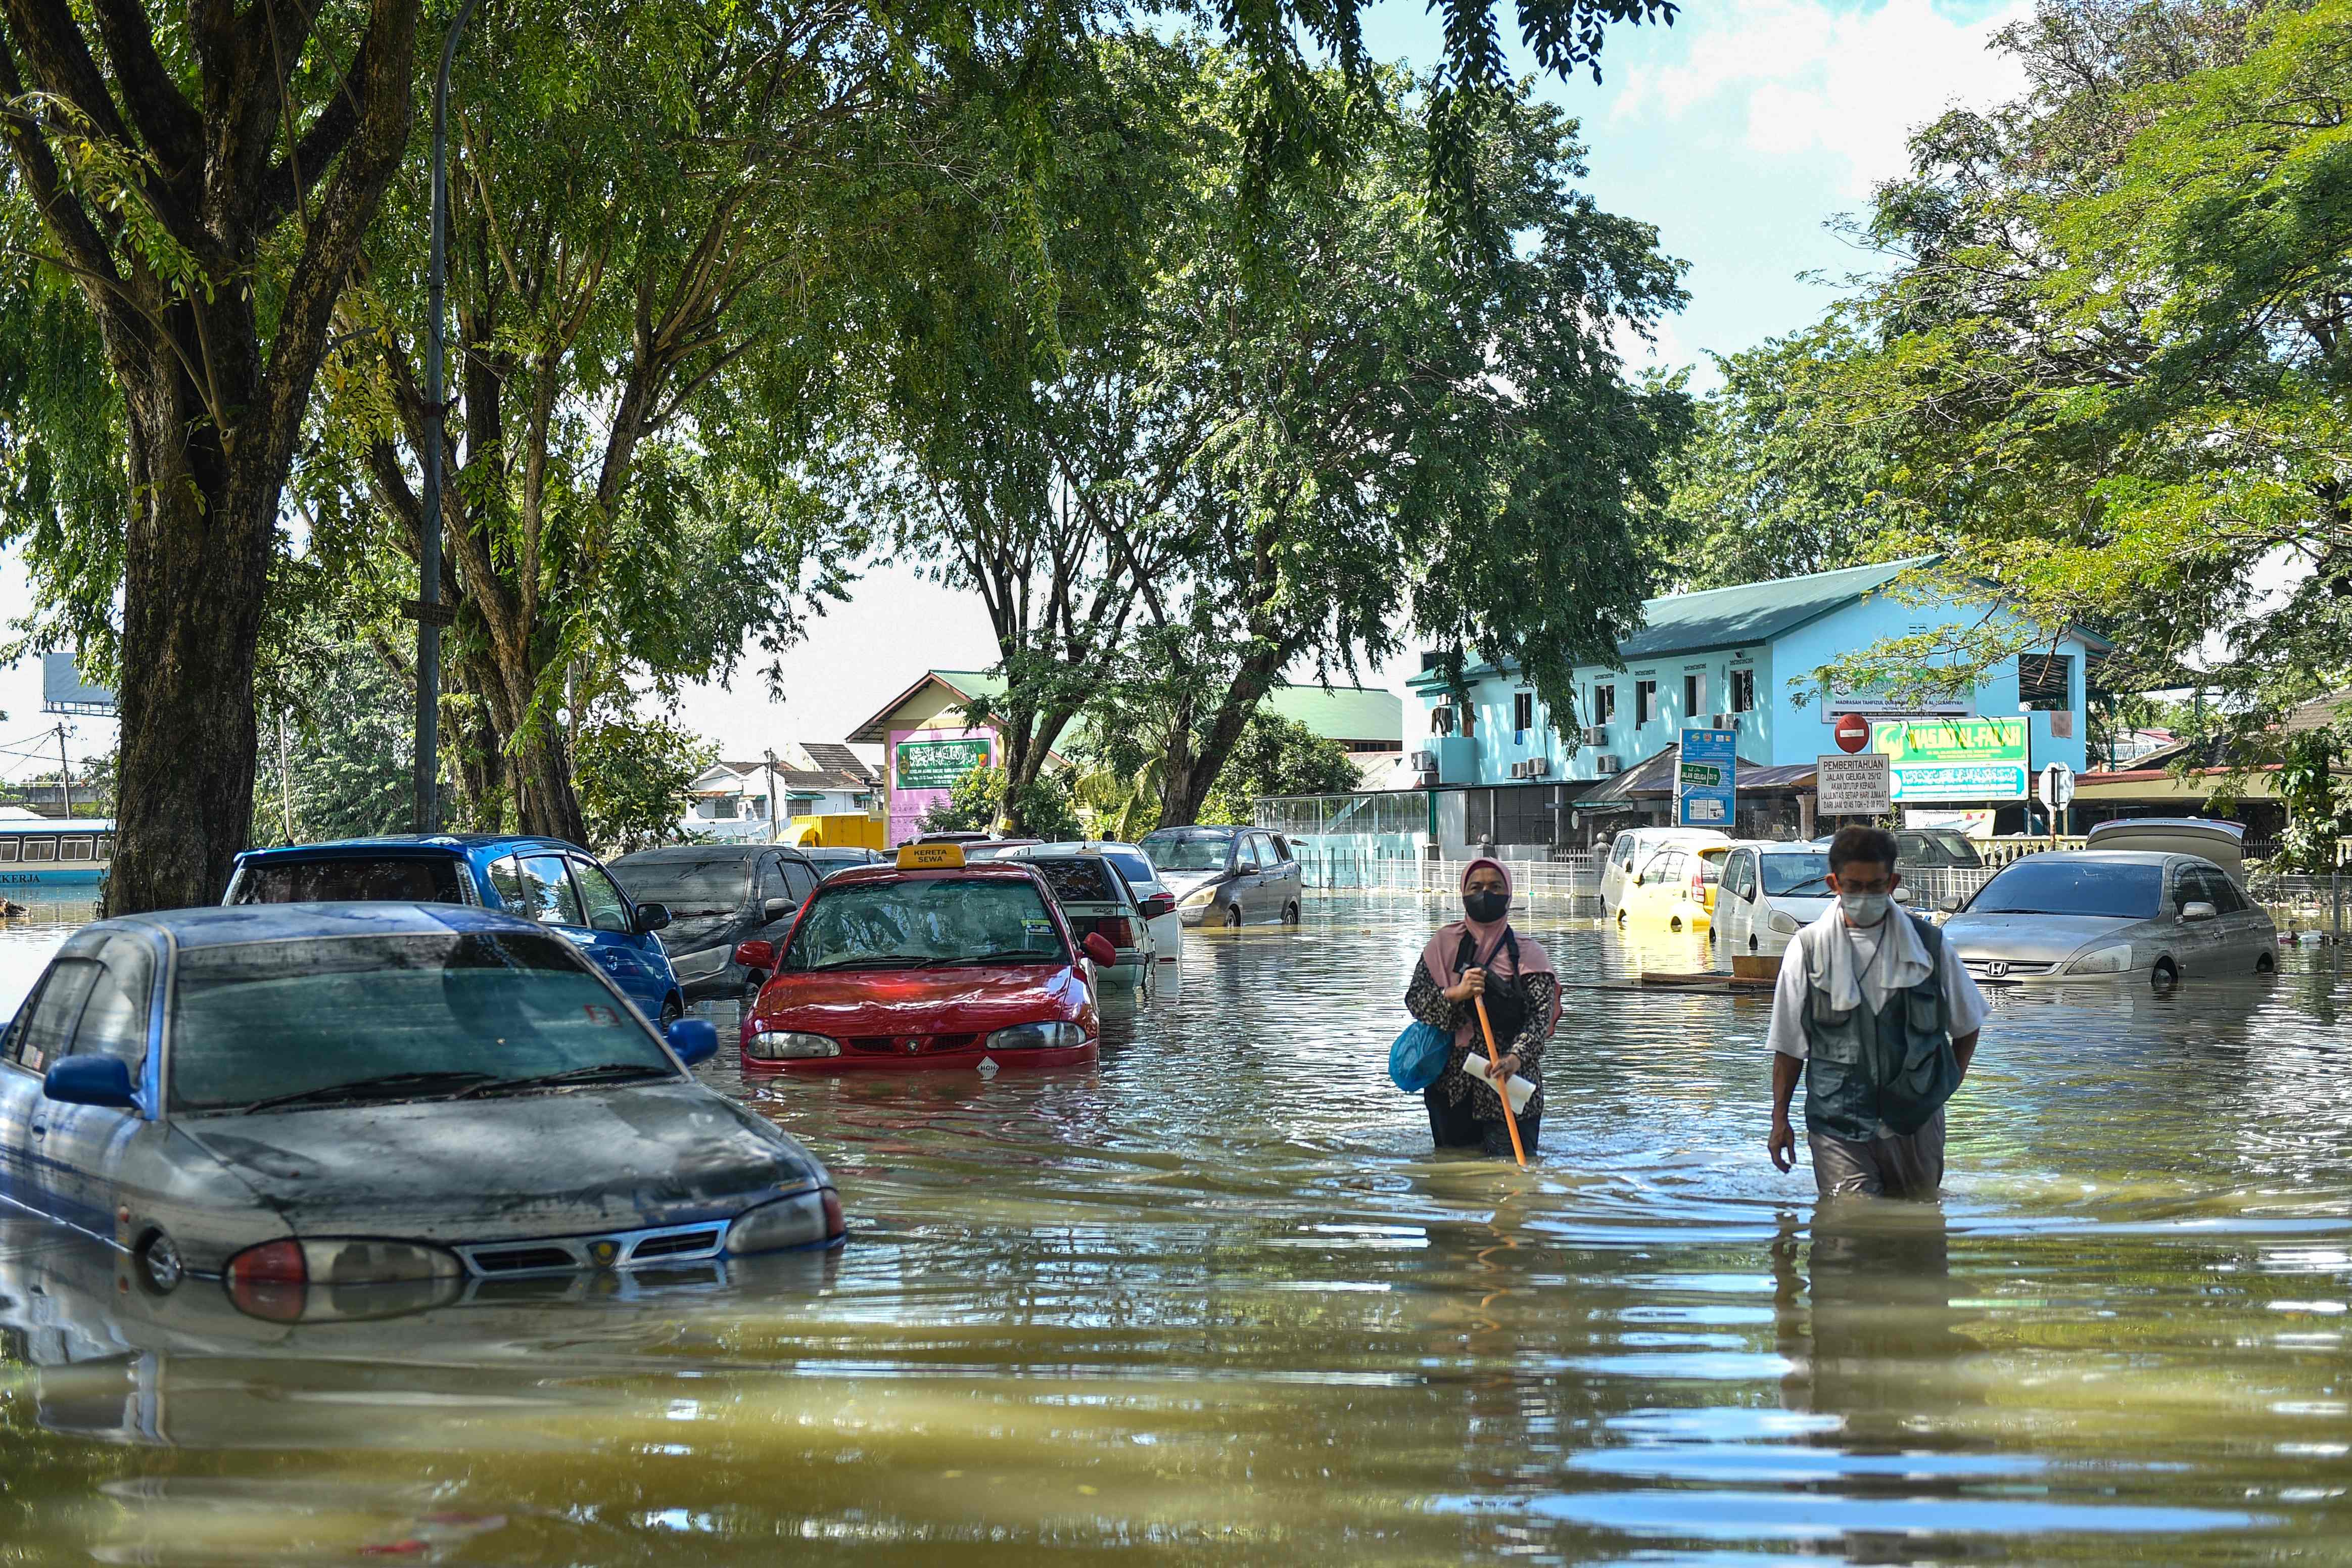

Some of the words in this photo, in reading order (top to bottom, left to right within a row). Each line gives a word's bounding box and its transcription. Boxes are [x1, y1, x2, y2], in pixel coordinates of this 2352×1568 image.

[1958, 726, 2020, 748] AL-FALAH
[1823, 759, 1884, 770] PEMBERITAHUAN
[1826, 773, 1844, 781] JALAN
[1846, 772, 1866, 780] GELIGA
[1868, 772, 1881, 780] 25/12
[1843, 782, 1859, 790] DITUTUP
[1860, 781, 1876, 789] KEPADA
[1870, 790, 1887, 798] JUMAAT
[0, 874, 40, 883] KERJA
